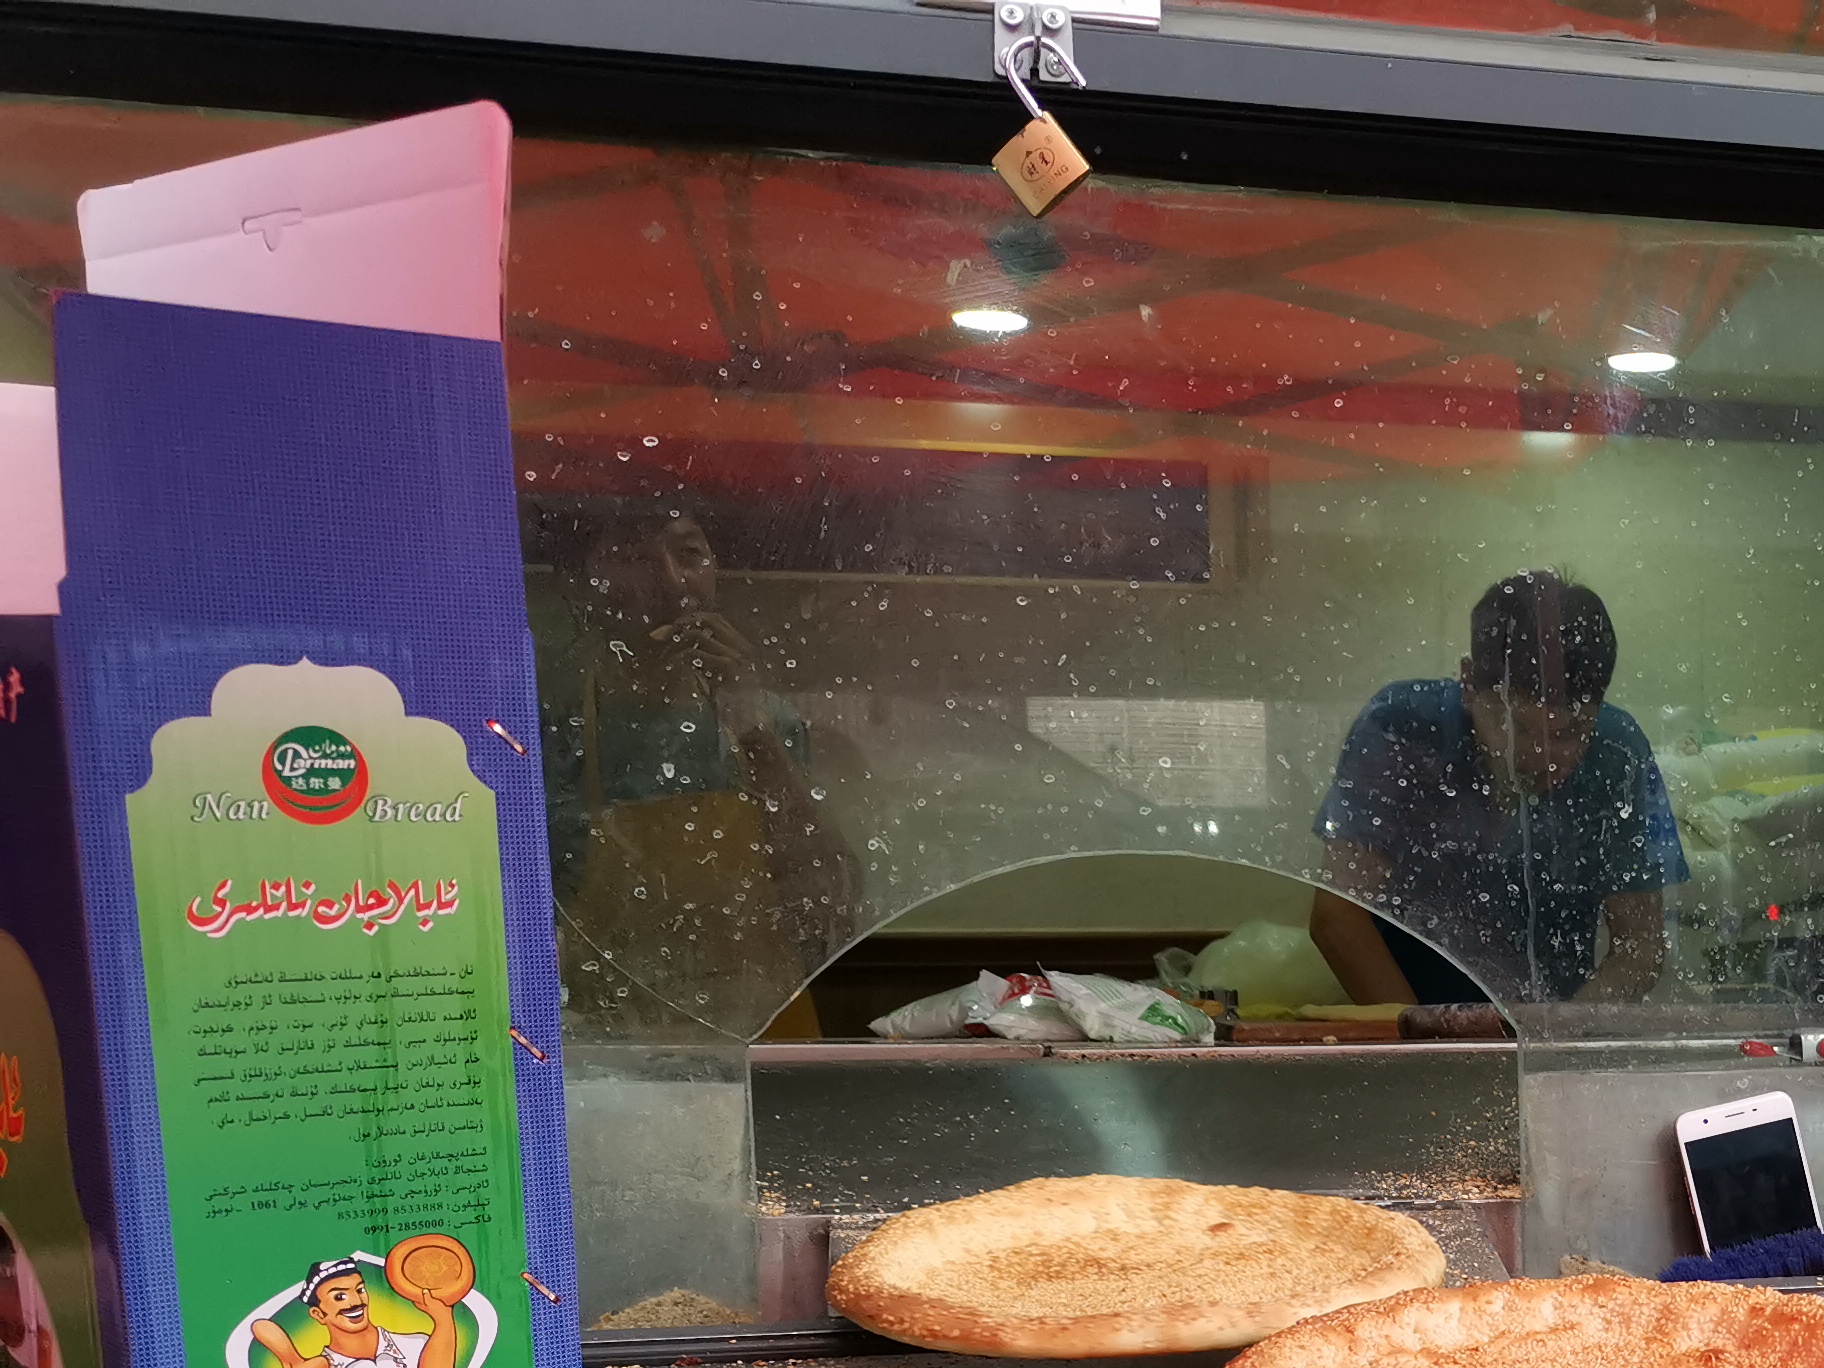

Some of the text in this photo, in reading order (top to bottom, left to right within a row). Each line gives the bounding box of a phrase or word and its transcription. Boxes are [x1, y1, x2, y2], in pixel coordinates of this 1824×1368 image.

[190, 790, 471, 823] Nan Bread
[185, 876, 460, 938] ئابلاجان نانلىرى
[458, 963, 474, 980] نان
[463, 1050, 481, 1069] خام
[249, 1198, 279, 1211] 1061
[392, 1202, 445, 1216] 8533888
[336, 1206, 390, 1221] 8533999
[362, 1218, 445, 1236] 0991-2855000
